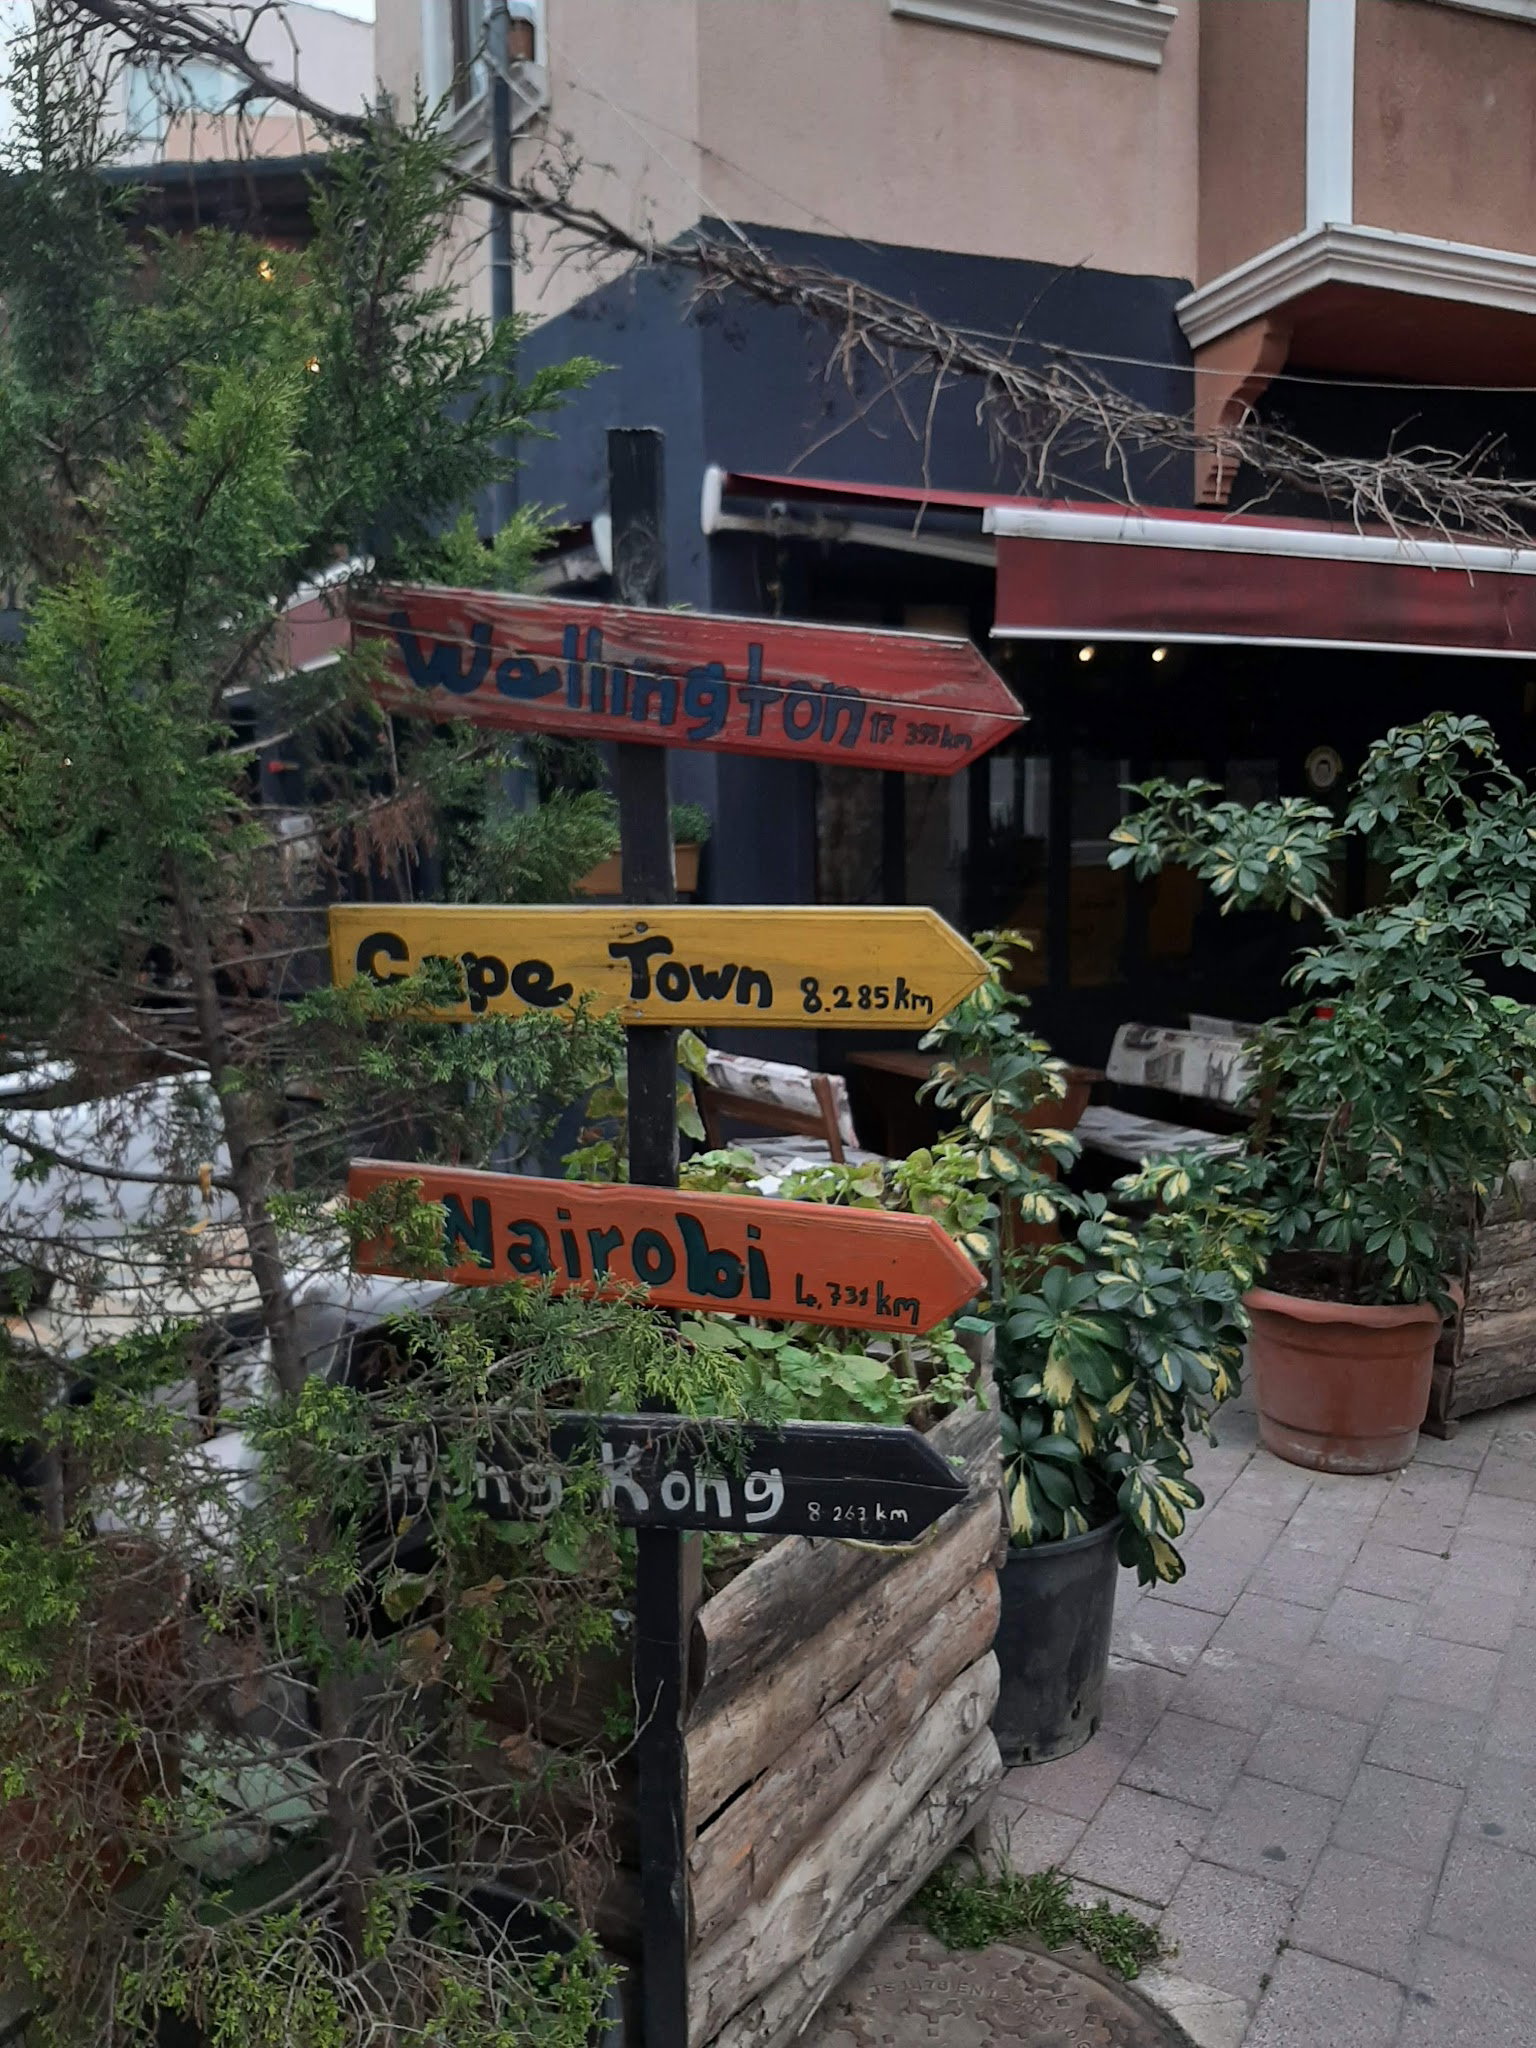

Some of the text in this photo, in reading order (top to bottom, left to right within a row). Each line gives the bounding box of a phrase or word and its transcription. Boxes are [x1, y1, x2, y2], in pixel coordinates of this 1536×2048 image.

[389, 611, 867, 748] Wellington
[357, 931, 573, 1013] Cpe
[608, 935, 774, 1009] Town
[442, 1193, 771, 1300] Nairobi
[600, 1442, 785, 1524] Kong
[875, 1502, 909, 1523] km
